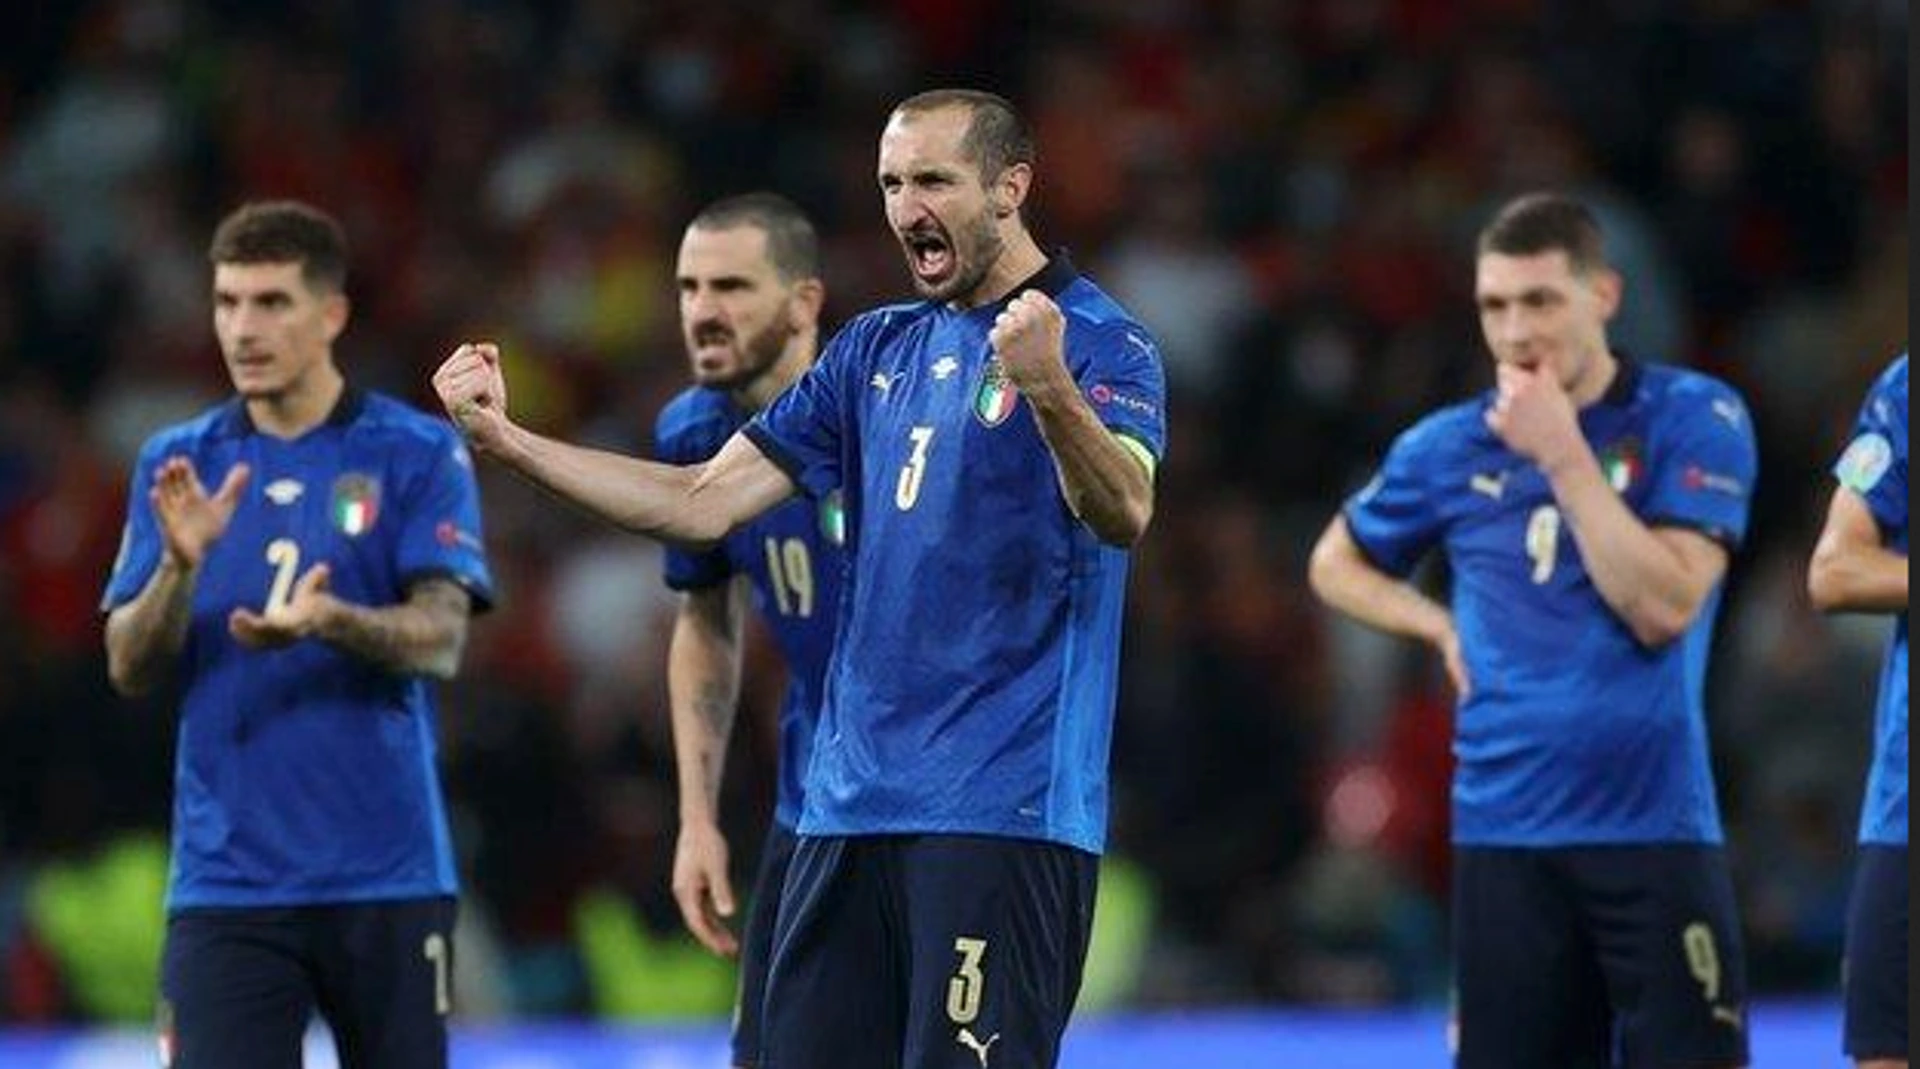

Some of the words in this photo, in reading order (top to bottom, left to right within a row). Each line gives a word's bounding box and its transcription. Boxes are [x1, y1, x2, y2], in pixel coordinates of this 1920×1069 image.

[896, 427, 934, 511] 3
[266, 538, 299, 619] 2
[764, 537, 813, 618] 19
[1526, 505, 1559, 584] 9
[947, 937, 987, 1023] 3
[1684, 923, 1720, 1001] 9
